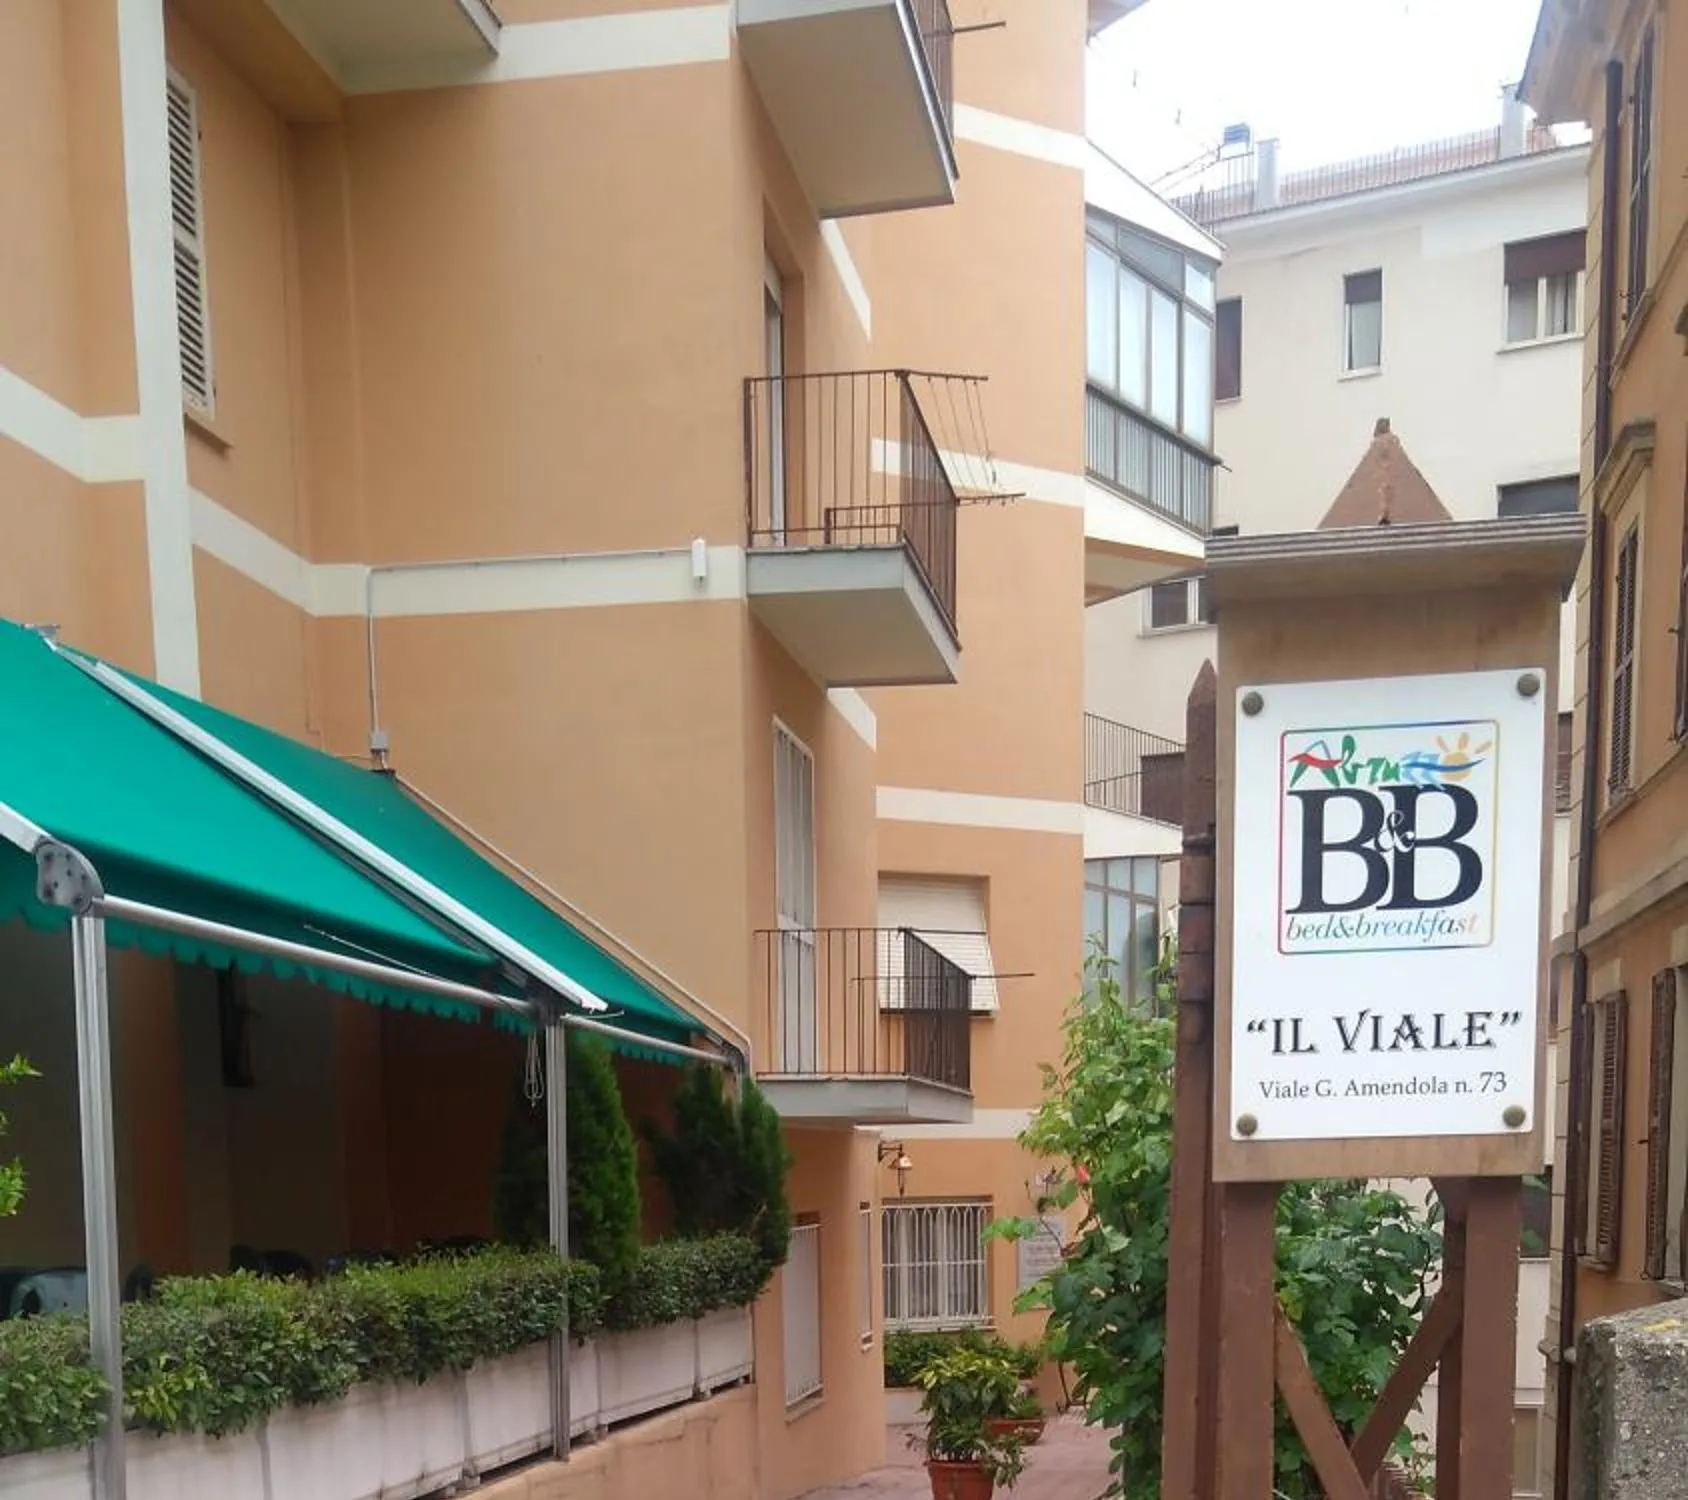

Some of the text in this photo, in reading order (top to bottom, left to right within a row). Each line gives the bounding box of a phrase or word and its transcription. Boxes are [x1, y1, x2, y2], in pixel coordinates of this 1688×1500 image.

[1285, 783, 1483, 914] B&B
[1286, 910, 1479, 943] bed&breakfast
[1258, 1070, 1507, 1099] Viale G. Amendola n. 73
